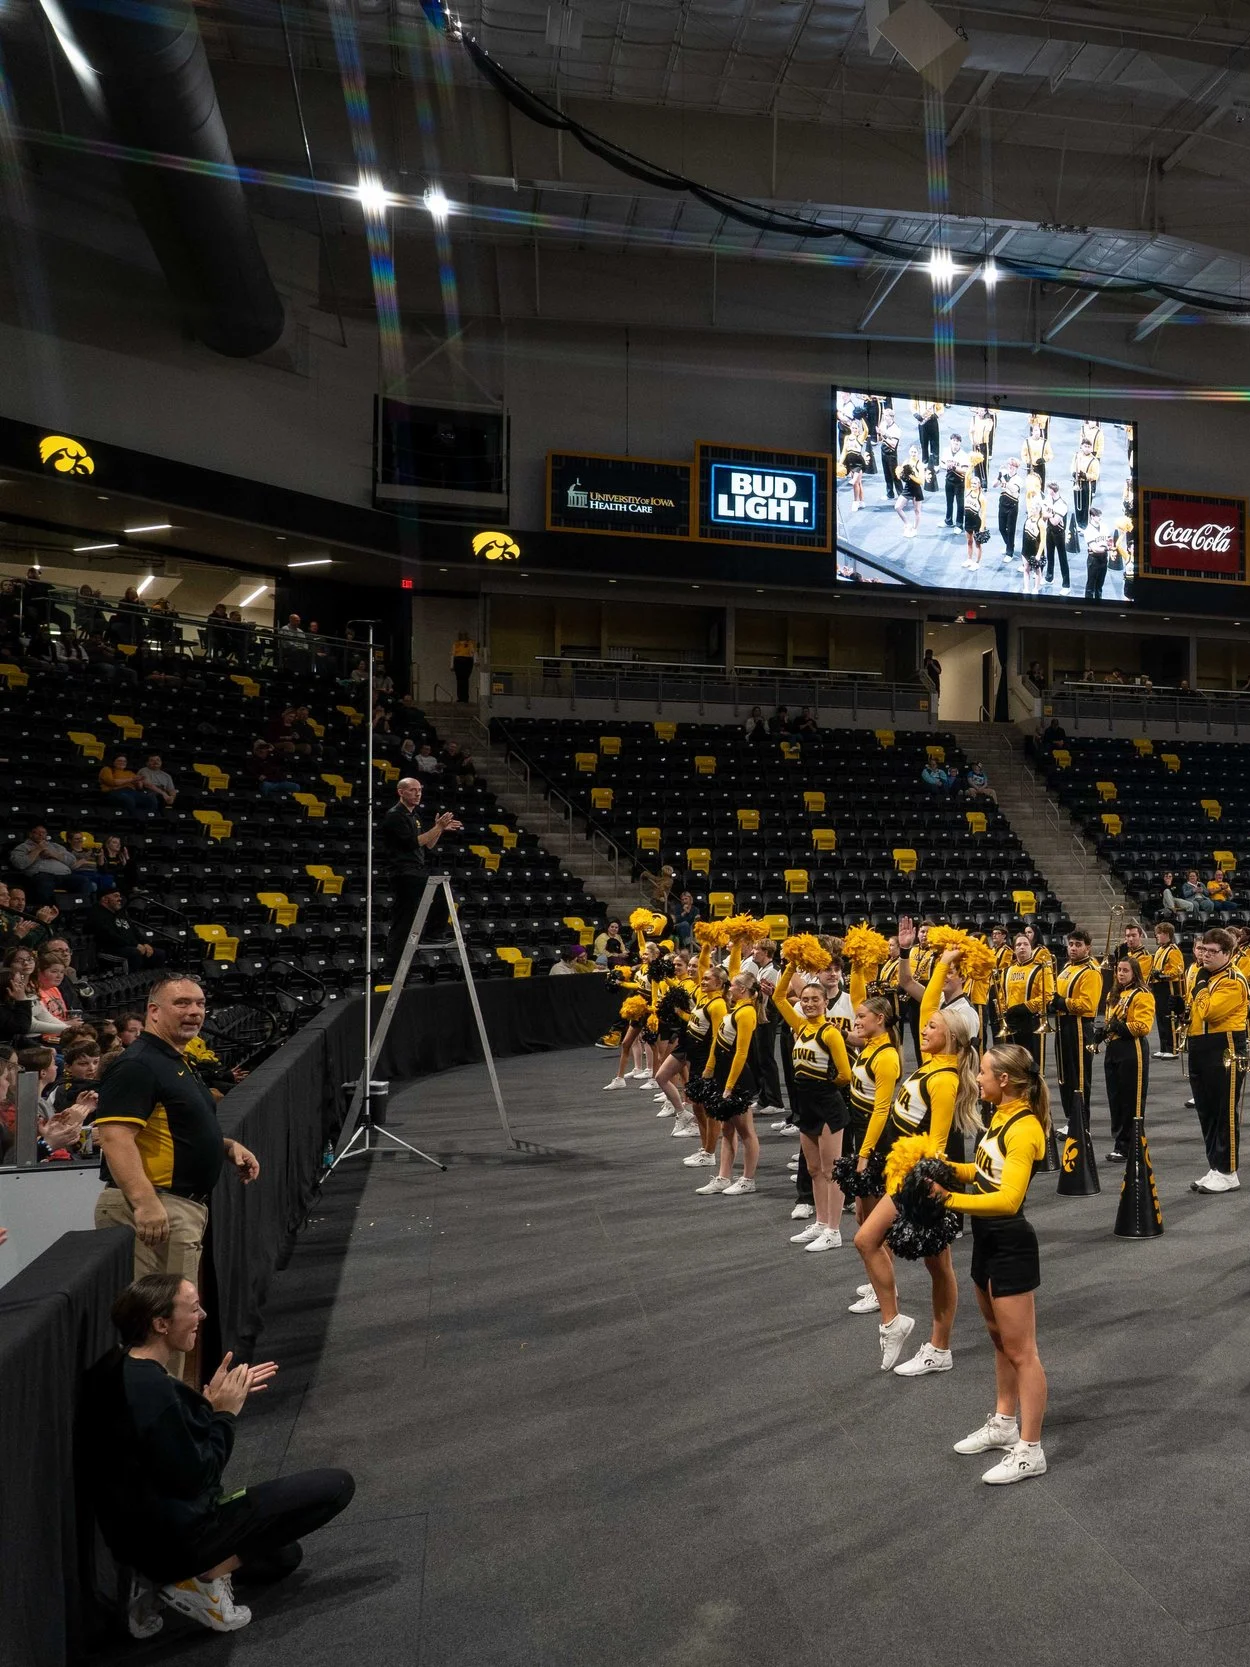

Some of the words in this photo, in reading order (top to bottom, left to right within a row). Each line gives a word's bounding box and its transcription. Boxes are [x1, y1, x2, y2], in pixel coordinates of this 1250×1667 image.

[731, 472, 797, 498] BUD
[590, 492, 641, 504] UNIVERSITY
[650, 497, 675, 507] IOWA
[590, 500, 627, 512] HEALTH
[628, 503, 653, 514] CARE
[1154, 519, 1236, 553] Coca-Cola
[792, 1048, 818, 1063] OWA
